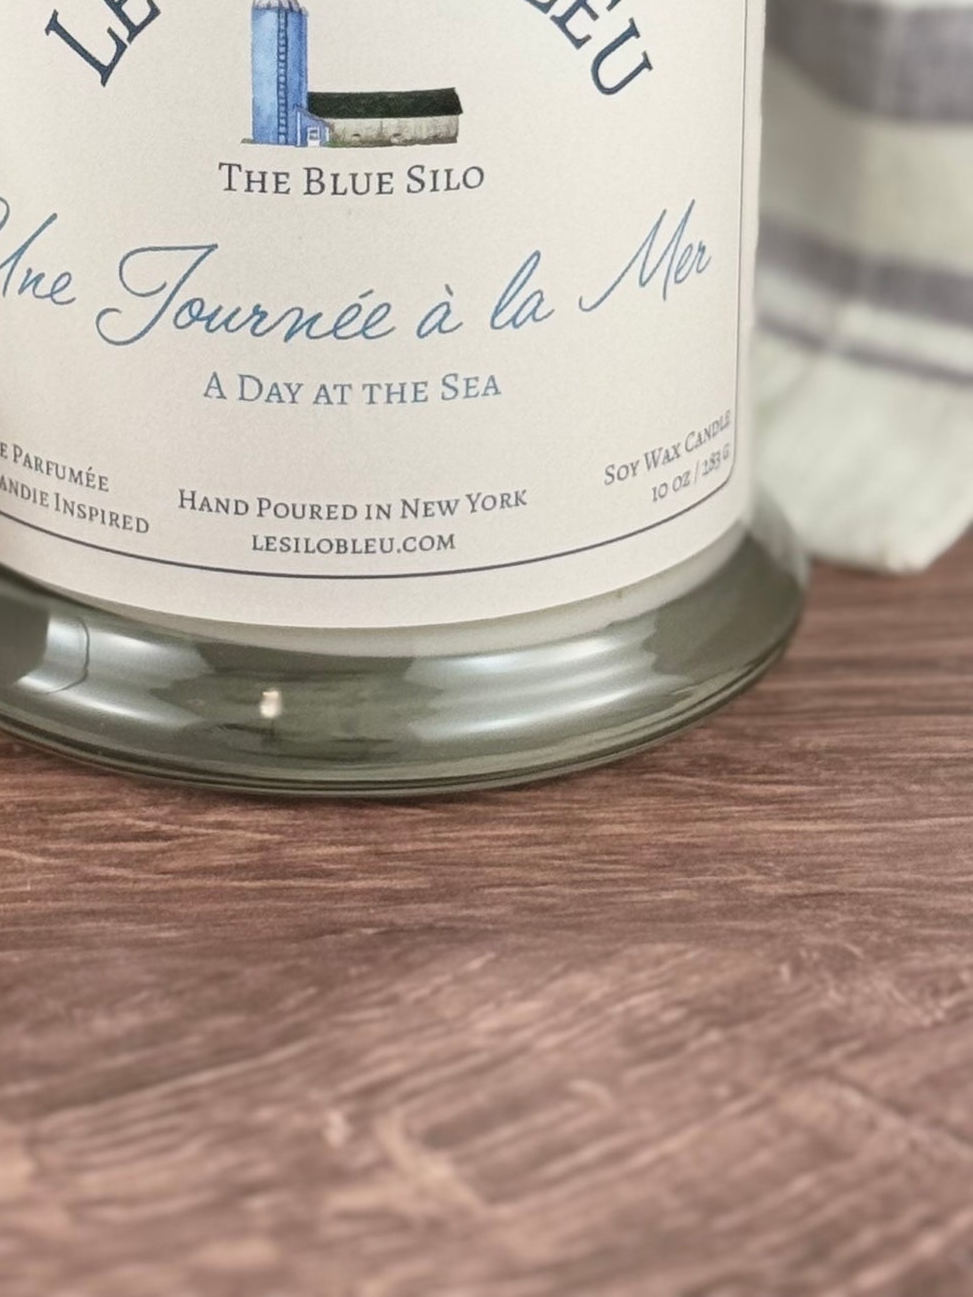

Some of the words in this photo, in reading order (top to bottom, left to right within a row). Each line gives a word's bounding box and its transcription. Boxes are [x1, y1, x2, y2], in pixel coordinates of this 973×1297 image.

[216, 160, 293, 197] THE
[302, 165, 396, 198] BLUE
[405, 163, 486, 196] SILO
[94, 242, 397, 347] Journée
[414, 282, 464, 341] à
[488, 248, 556, 331] la
[577, 197, 713, 314] Mer
[201, 370, 229, 401] A
[236, 372, 306, 405] DAY
[311, 382, 354, 406] AT
[361, 380, 430, 406] THE
[439, 372, 503, 402] SEA
[603, 459, 641, 487] SOY
[642, 442, 682, 473] WAX
[683, 408, 732, 453] CANDLE
[12, 443, 110, 493] PARFUMÉE
[651, 482, 670, 503] 10
[671, 469, 692, 493] OZ
[53, 491, 151, 534] INSPIRED
[177, 488, 251, 517] HAND
[255, 496, 359, 522] POURED
[364, 502, 394, 522] IN
[399, 497, 462, 521] NEW
[464, 488, 529, 515] YORK
[250, 532, 458, 556] LESILOBLEU.COM
